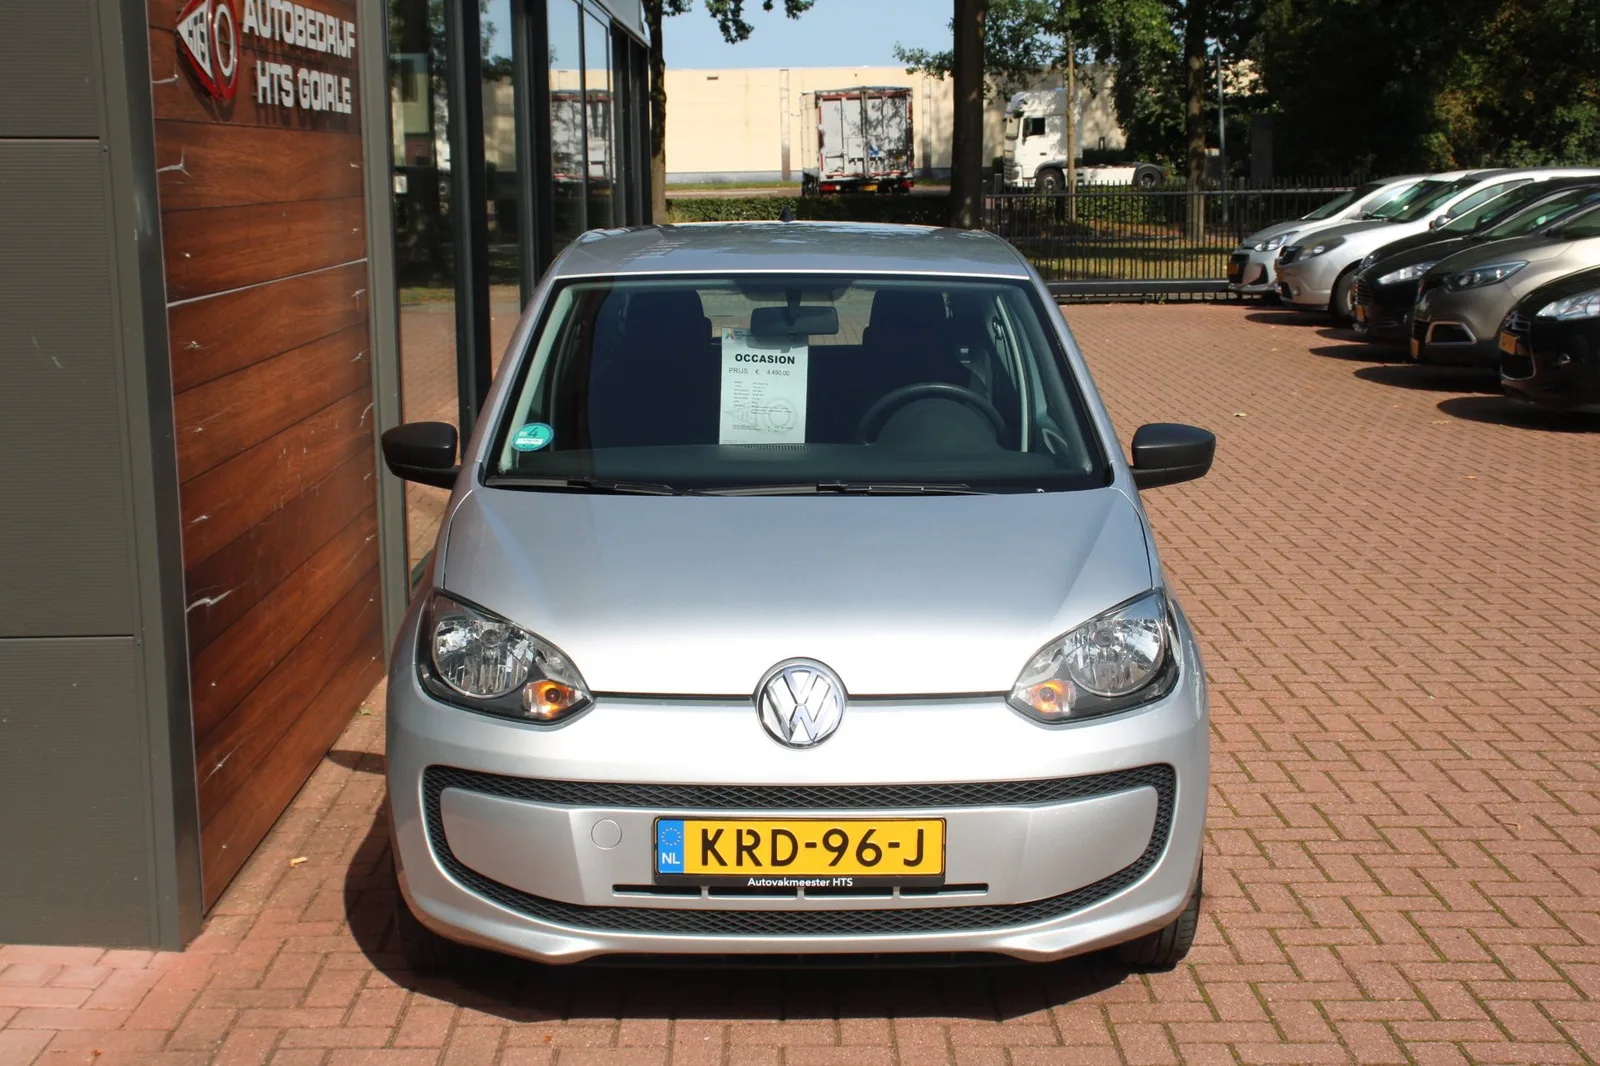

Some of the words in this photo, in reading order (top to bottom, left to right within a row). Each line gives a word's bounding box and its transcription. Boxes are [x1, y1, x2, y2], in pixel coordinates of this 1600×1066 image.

[243, 0, 355, 58] AUTOBEDRIJF
[256, 60, 294, 108] HTS
[299, 68, 352, 113] GOIRLE
[728, 367, 748, 375] PRIJS
[735, 353, 795, 364] OCCASION
[661, 852, 680, 865] NL
[701, 828, 924, 867] KRD-96-J
[747, 878, 831, 887] Autovakmeester
[832, 878, 853, 887] HTS
